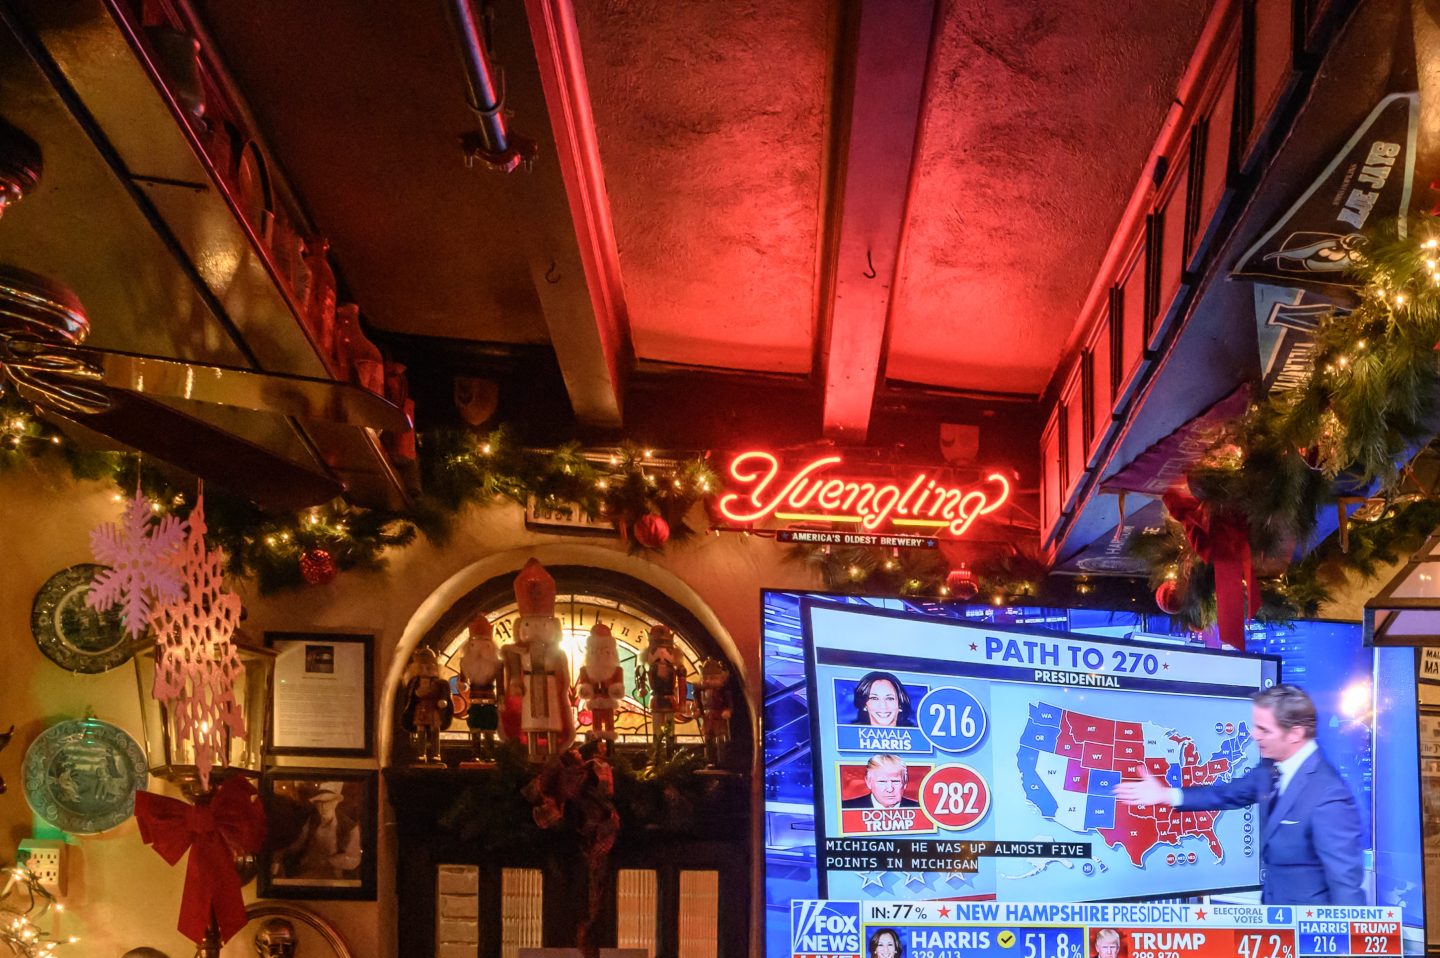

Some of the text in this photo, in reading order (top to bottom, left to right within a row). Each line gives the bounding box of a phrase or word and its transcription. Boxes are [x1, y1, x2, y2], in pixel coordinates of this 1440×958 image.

[1358, 141, 1400, 187] JAYS
[720, 451, 1010, 536] Yuengling
[792, 532, 924, 547] AMERICA'S OLDEST BREWERY
[985, 637, 1159, 675] PATH TO 270
[1035, 670, 1120, 688] PRESIDENTIAL
[929, 703, 976, 738] 216
[858, 728, 912, 740] KAMALA
[860, 738, 912, 750] HARRIS
[933, 782, 979, 815] 282
[862, 810, 916, 822] DONALD
[864, 820, 914, 832] TRUMP
[826, 840, 1084, 856] MICHIGAN, HE WAS UP ALMOST FIVE
[826, 857, 978, 870] POINTS IN MICHIGAN
[956, 905, 1190, 923] NEW HAMPSHIRE PRESIDENT
[1213, 908, 1263, 916] ELECTORAL
[1234, 909, 1284, 924] VOTES 4
[1317, 908, 1383, 920] PRESIDENT
[815, 915, 857, 933] FOX
[1301, 922, 1397, 934] HARRIS TRUMP
[802, 935, 859, 952] NEWS
[911, 931, 990, 949] HARRIS
[1131, 932, 1206, 951] TRUMP
[1313, 937, 1388, 954] 216 232
